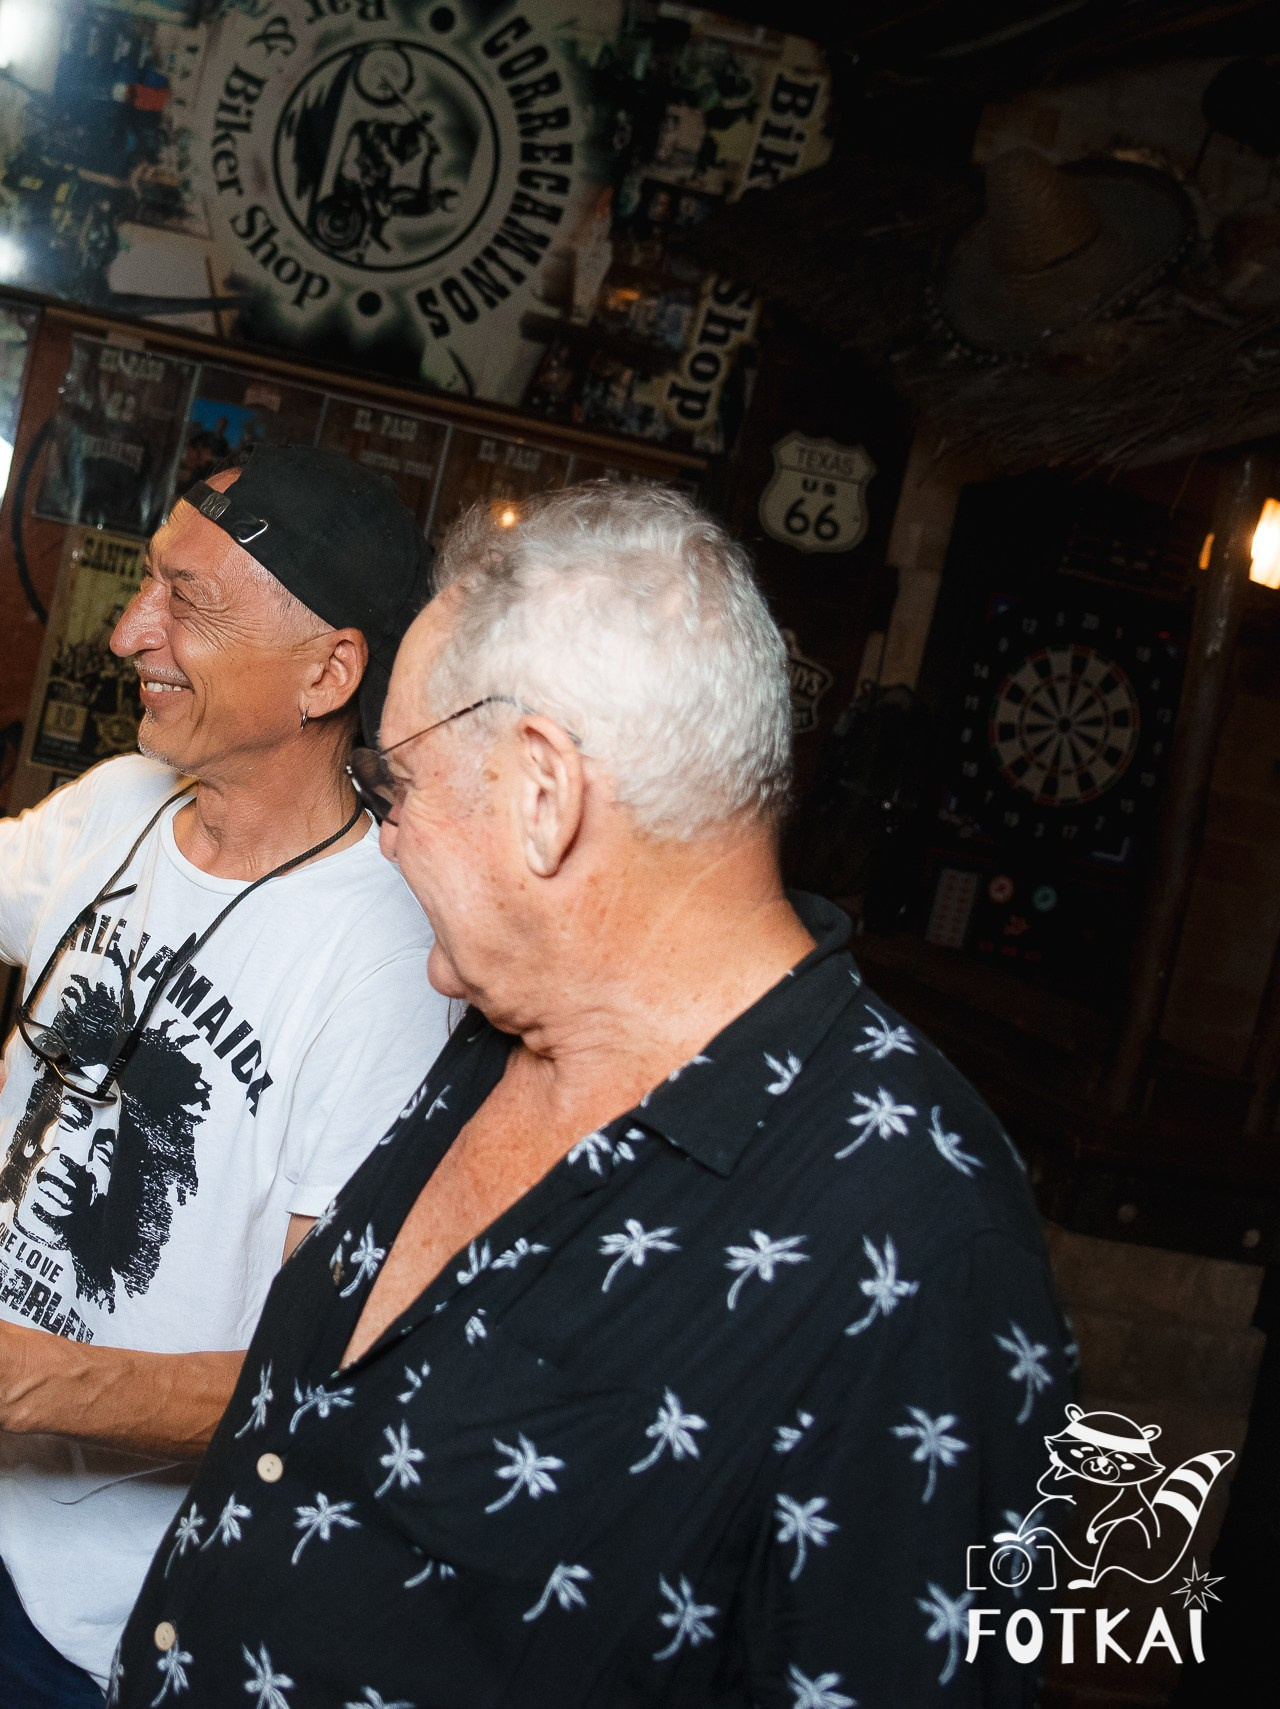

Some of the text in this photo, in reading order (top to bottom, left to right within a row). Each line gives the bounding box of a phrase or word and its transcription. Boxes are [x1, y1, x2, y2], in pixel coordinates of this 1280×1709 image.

[248, 15, 297, 58] &
[210, 63, 268, 197] Biker
[416, 16, 575, 340] CORRECAMINOS
[229, 204, 330, 310] Shop
[668, 73, 818, 421] Bik Shop
[796, 446, 855, 477] TEXAS
[785, 497, 840, 541] 66
[81, 537, 142, 579] SANTI
[974, 663, 989, 678] 14
[965, 695, 979, 710] 11
[1062, 825, 1078, 839] 17
[130, 931, 274, 1118] JAMAICA
[15, 1241, 64, 1284] LOVE
